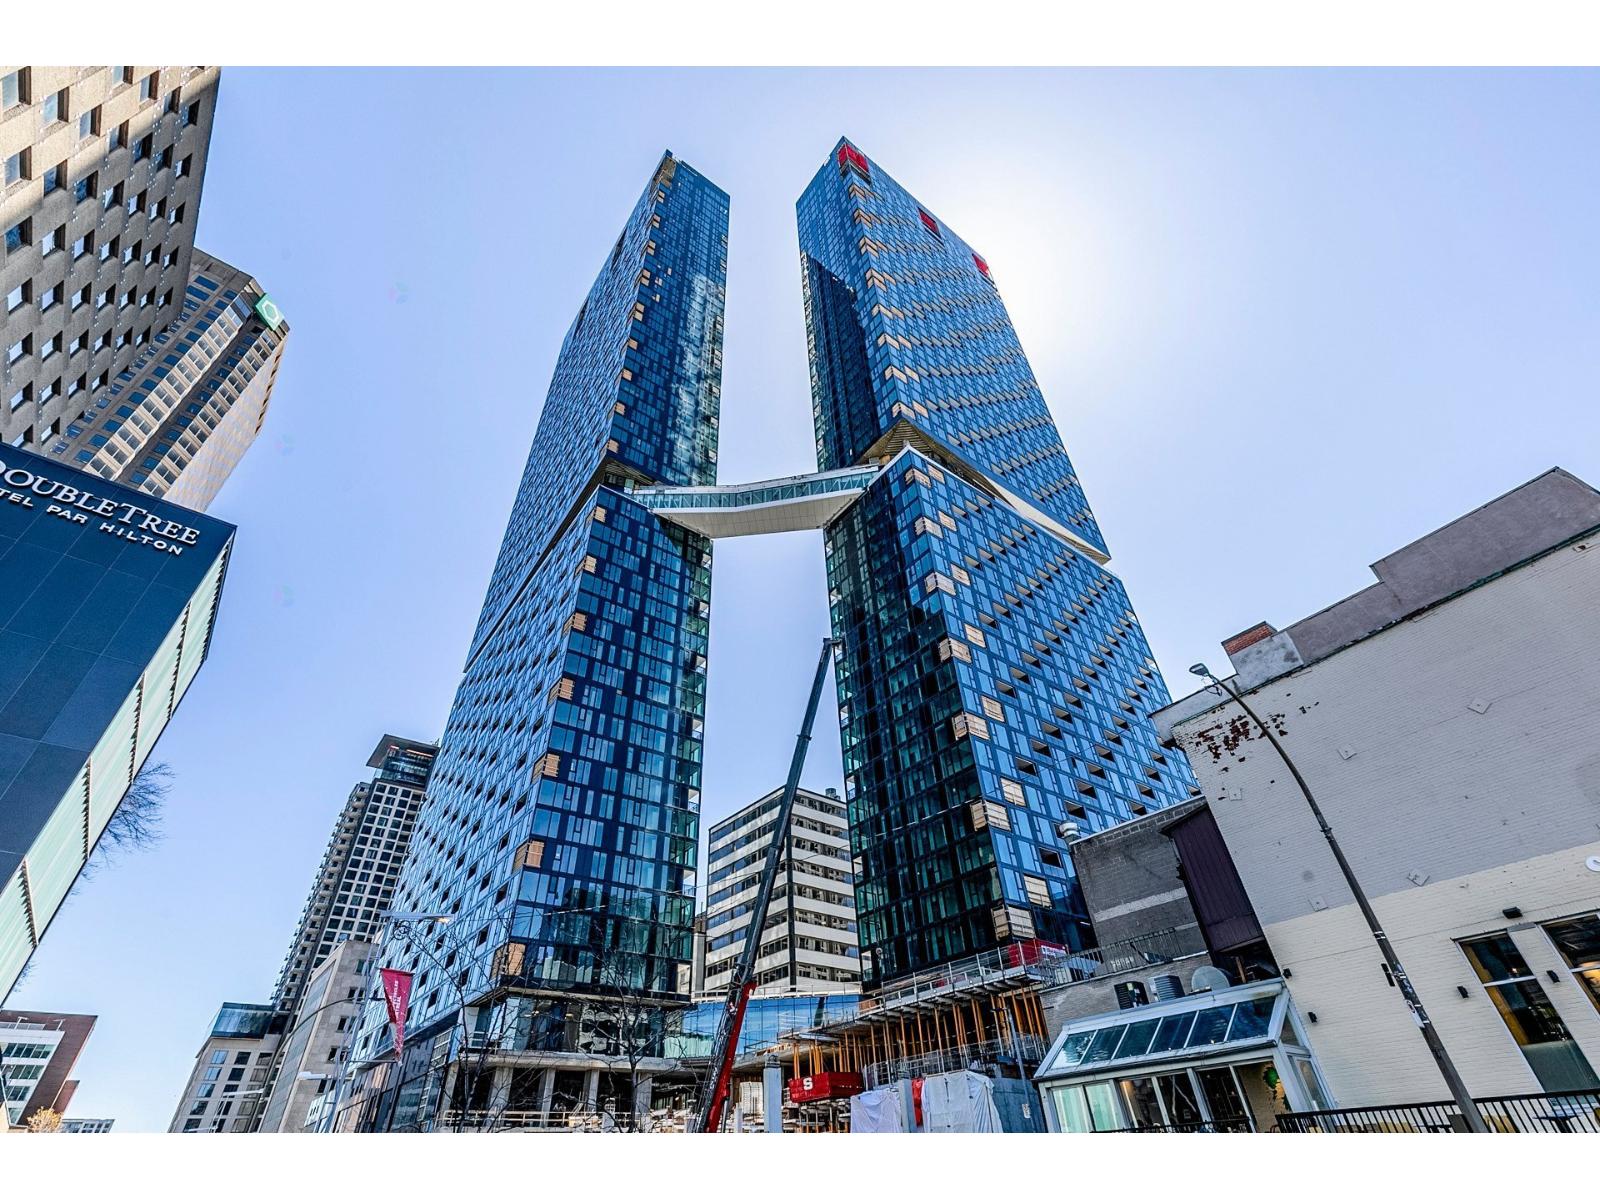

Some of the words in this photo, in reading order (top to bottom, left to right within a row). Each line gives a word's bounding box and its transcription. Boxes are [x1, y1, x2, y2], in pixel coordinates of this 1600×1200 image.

[0, 459, 200, 544] OUBLETREE
[46, 504, 88, 524] PAR
[100, 522, 183, 555] HILTON
[803, 1077, 813, 1091] S
